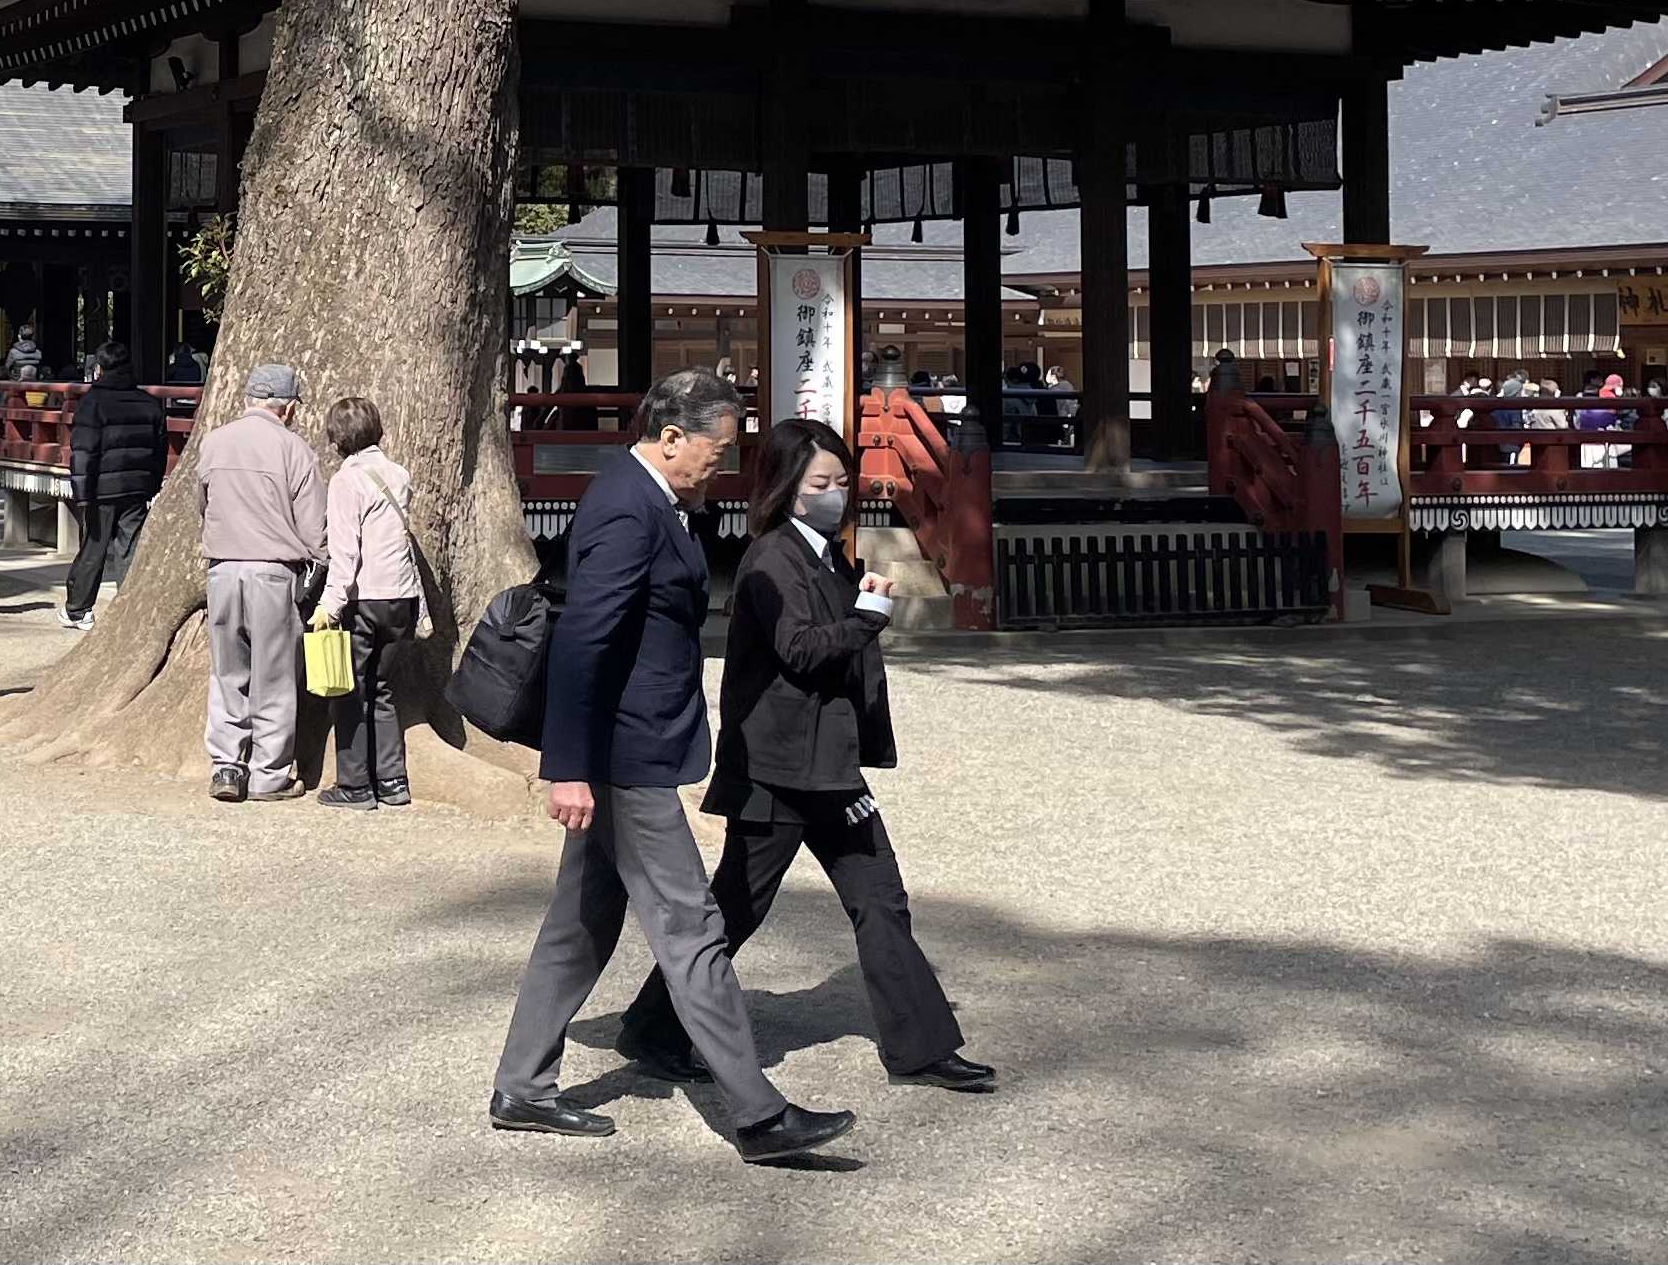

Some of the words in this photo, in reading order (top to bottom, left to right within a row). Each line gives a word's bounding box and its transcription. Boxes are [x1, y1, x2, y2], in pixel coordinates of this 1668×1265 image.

[794, 304, 817, 420] 御鎮座二千
[821, 293, 834, 349] 令和十年
[1380, 299, 1394, 352] 令和十年
[1352, 310, 1379, 508] 御鎮座二千五百年
